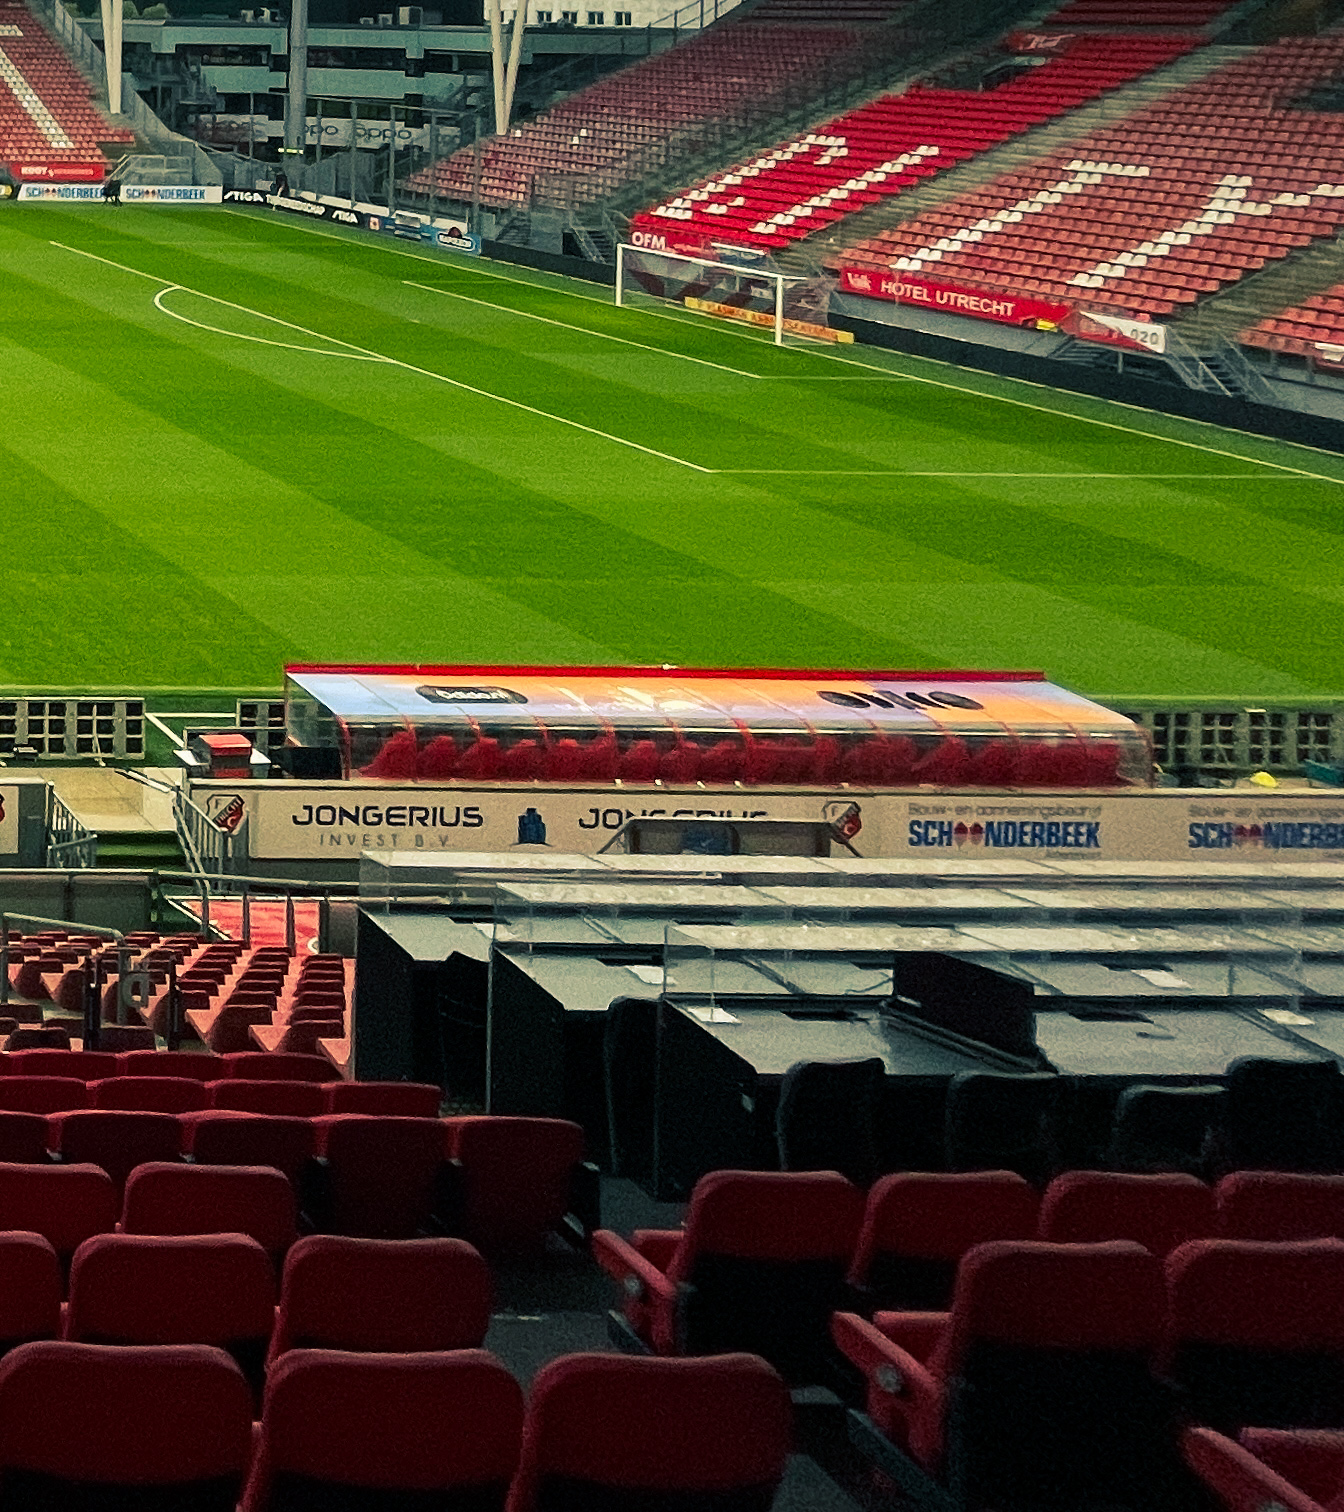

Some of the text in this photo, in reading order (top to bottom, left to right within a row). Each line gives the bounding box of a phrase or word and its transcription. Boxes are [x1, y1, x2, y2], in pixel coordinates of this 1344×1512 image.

[224, 190, 264, 203] STIGA
[880, 280, 933, 304] HOTEL
[935, 289, 1016, 317] UTRECHT
[291, 804, 484, 828] JONGERIUS
[319, 832, 398, 847] INVEST
